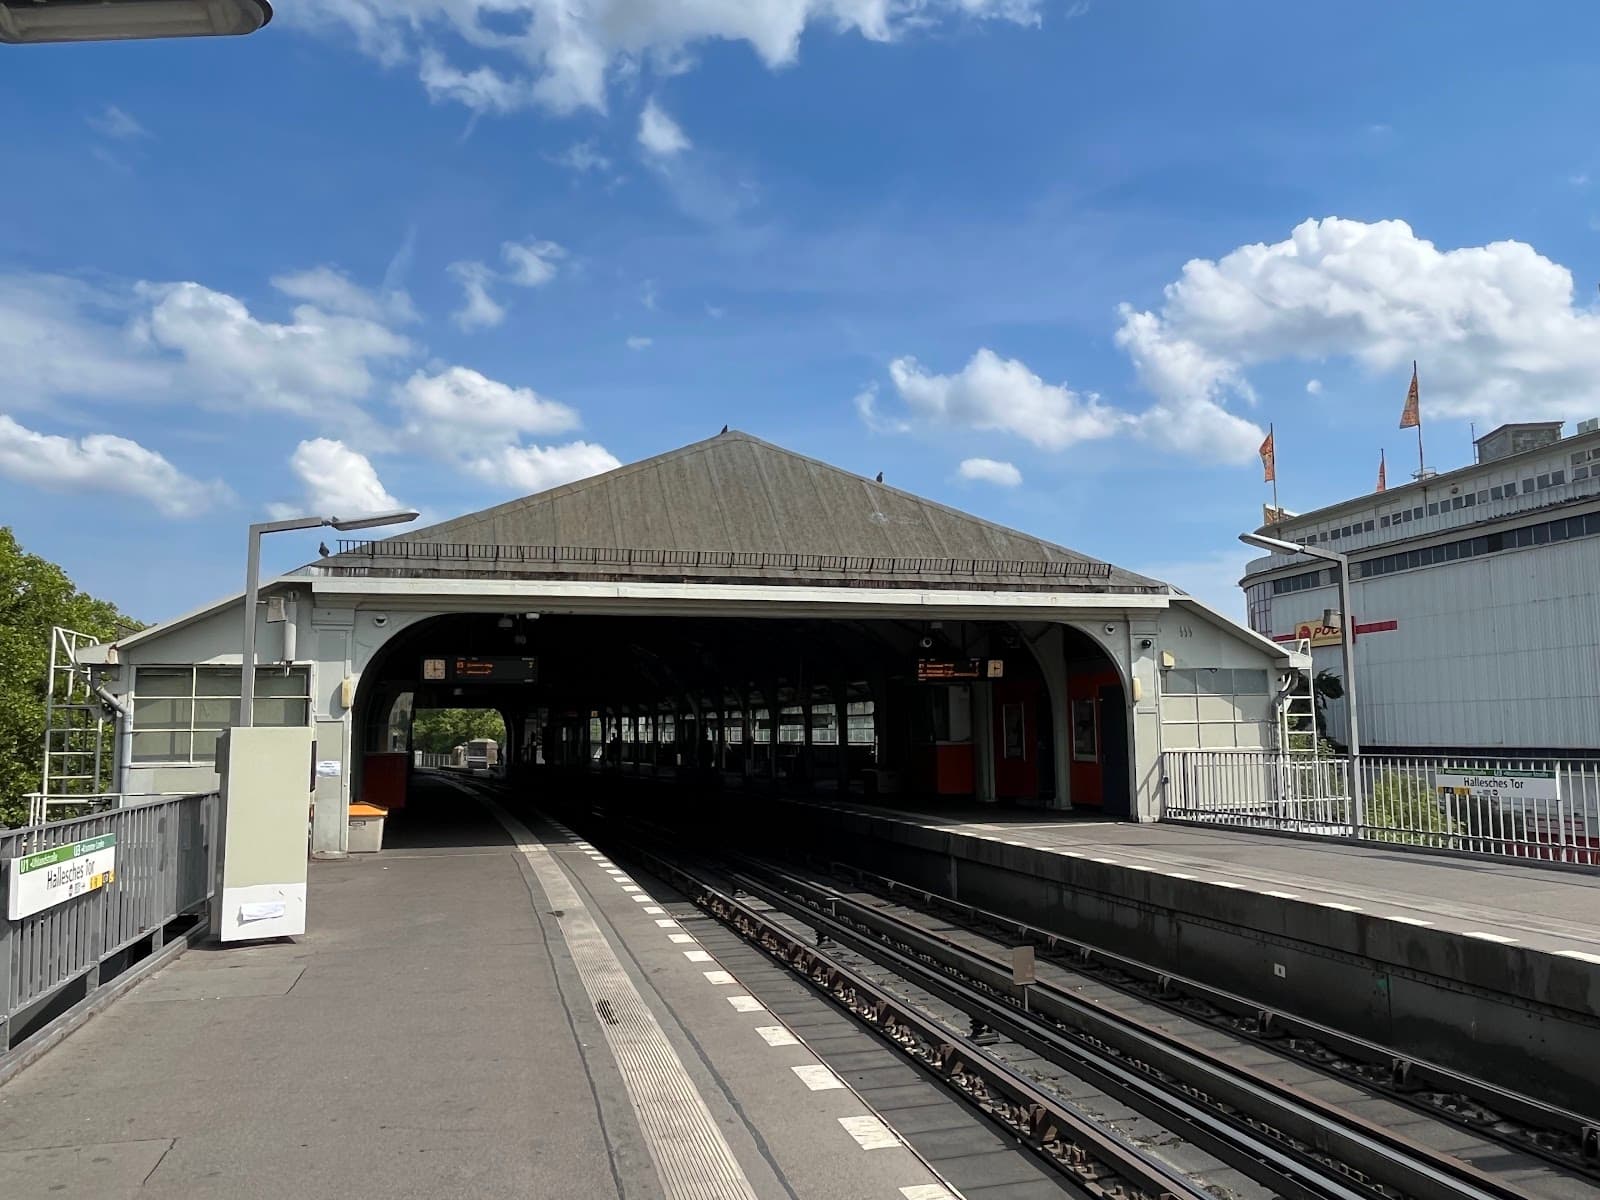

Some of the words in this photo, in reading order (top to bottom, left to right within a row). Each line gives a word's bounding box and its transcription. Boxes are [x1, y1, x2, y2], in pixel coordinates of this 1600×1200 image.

[1464, 777, 1508, 789] Hallesches
[1510, 779, 1524, 789] Tor
[20, 859, 29, 873] U1
[47, 864, 84, 890] Hallesches
[86, 858, 96, 876] Tor
